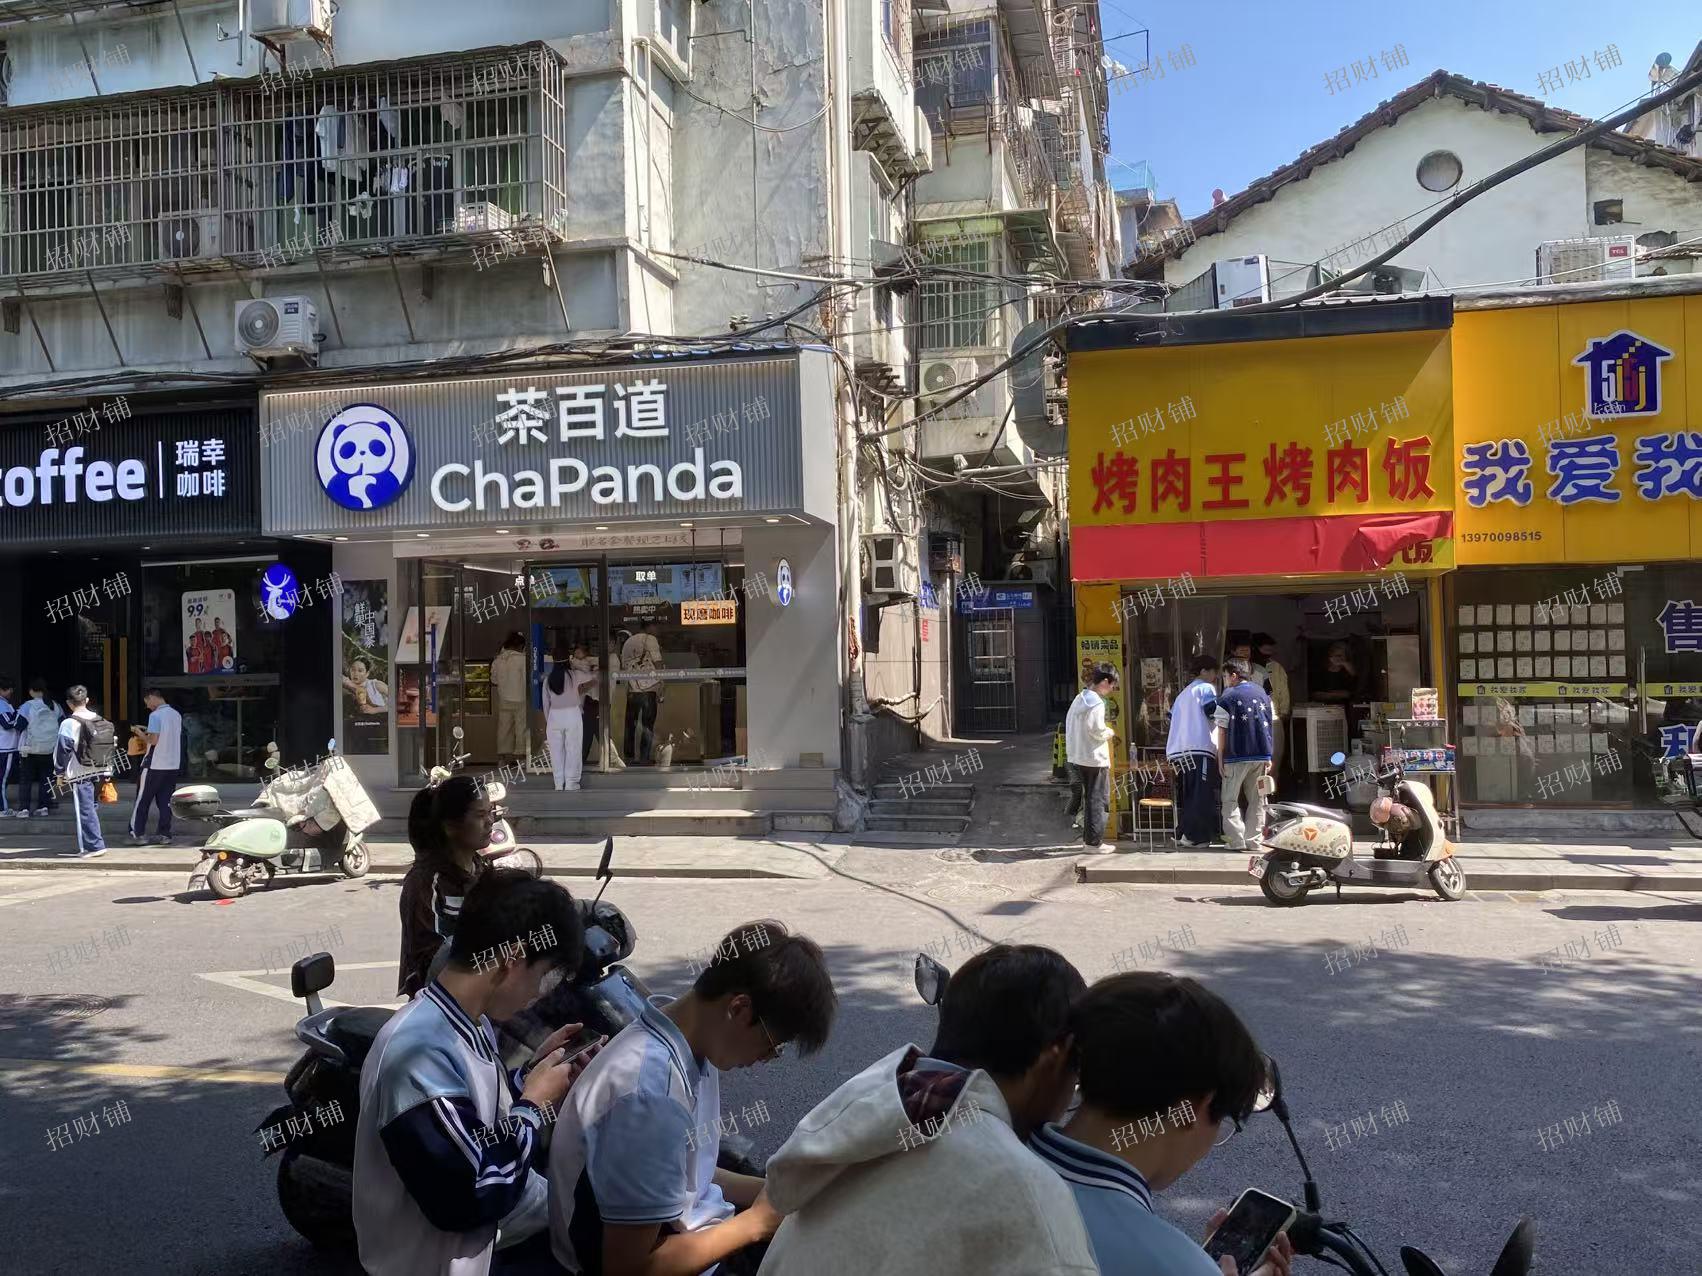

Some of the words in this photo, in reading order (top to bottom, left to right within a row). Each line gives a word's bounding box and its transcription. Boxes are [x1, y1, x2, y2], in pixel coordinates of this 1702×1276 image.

[495, 379, 671, 445] 茶百道
[0, 446, 146, 509] offee
[175, 438, 225, 468] 瑞幸
[1092, 435, 1435, 515] 烤肉王烤肉饭
[1461, 432, 1702, 508] 我爱我
[176, 471, 225, 498] 咖啡
[430, 447, 743, 513] ChaPanda
[1461, 531, 1542, 543] 13970098515
[635, 570, 657, 582] 取单
[364, 610, 376, 648] 中国茶
